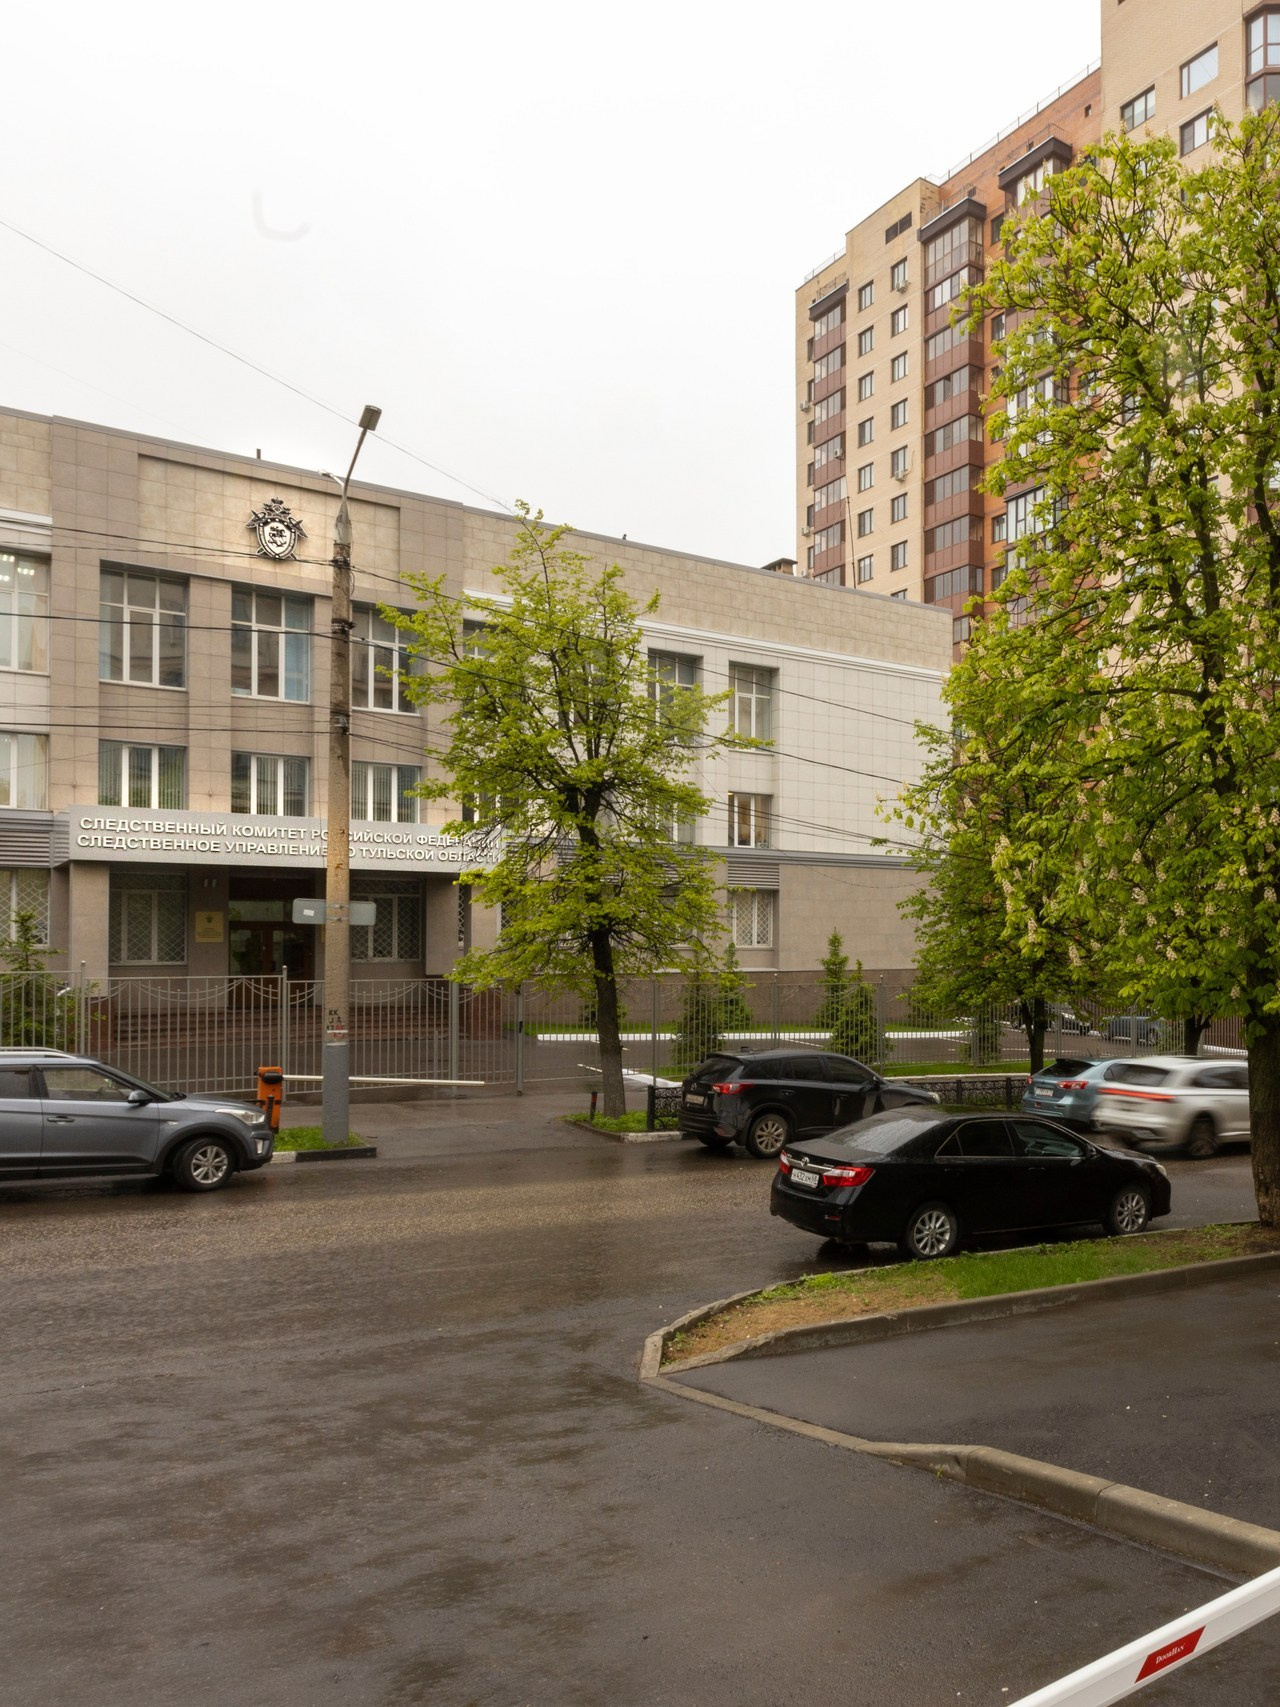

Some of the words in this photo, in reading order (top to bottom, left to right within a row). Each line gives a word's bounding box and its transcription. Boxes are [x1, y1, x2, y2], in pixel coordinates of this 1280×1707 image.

[80, 817, 227, 836] СЛЕДСТВЕННЫЙ
[232, 825, 306, 840] КОМИТЕТ
[77, 834, 221, 852] СЛЕДСТВЕННОЕ
[361, 847, 434, 861] ТУЛЬСКОЙ
